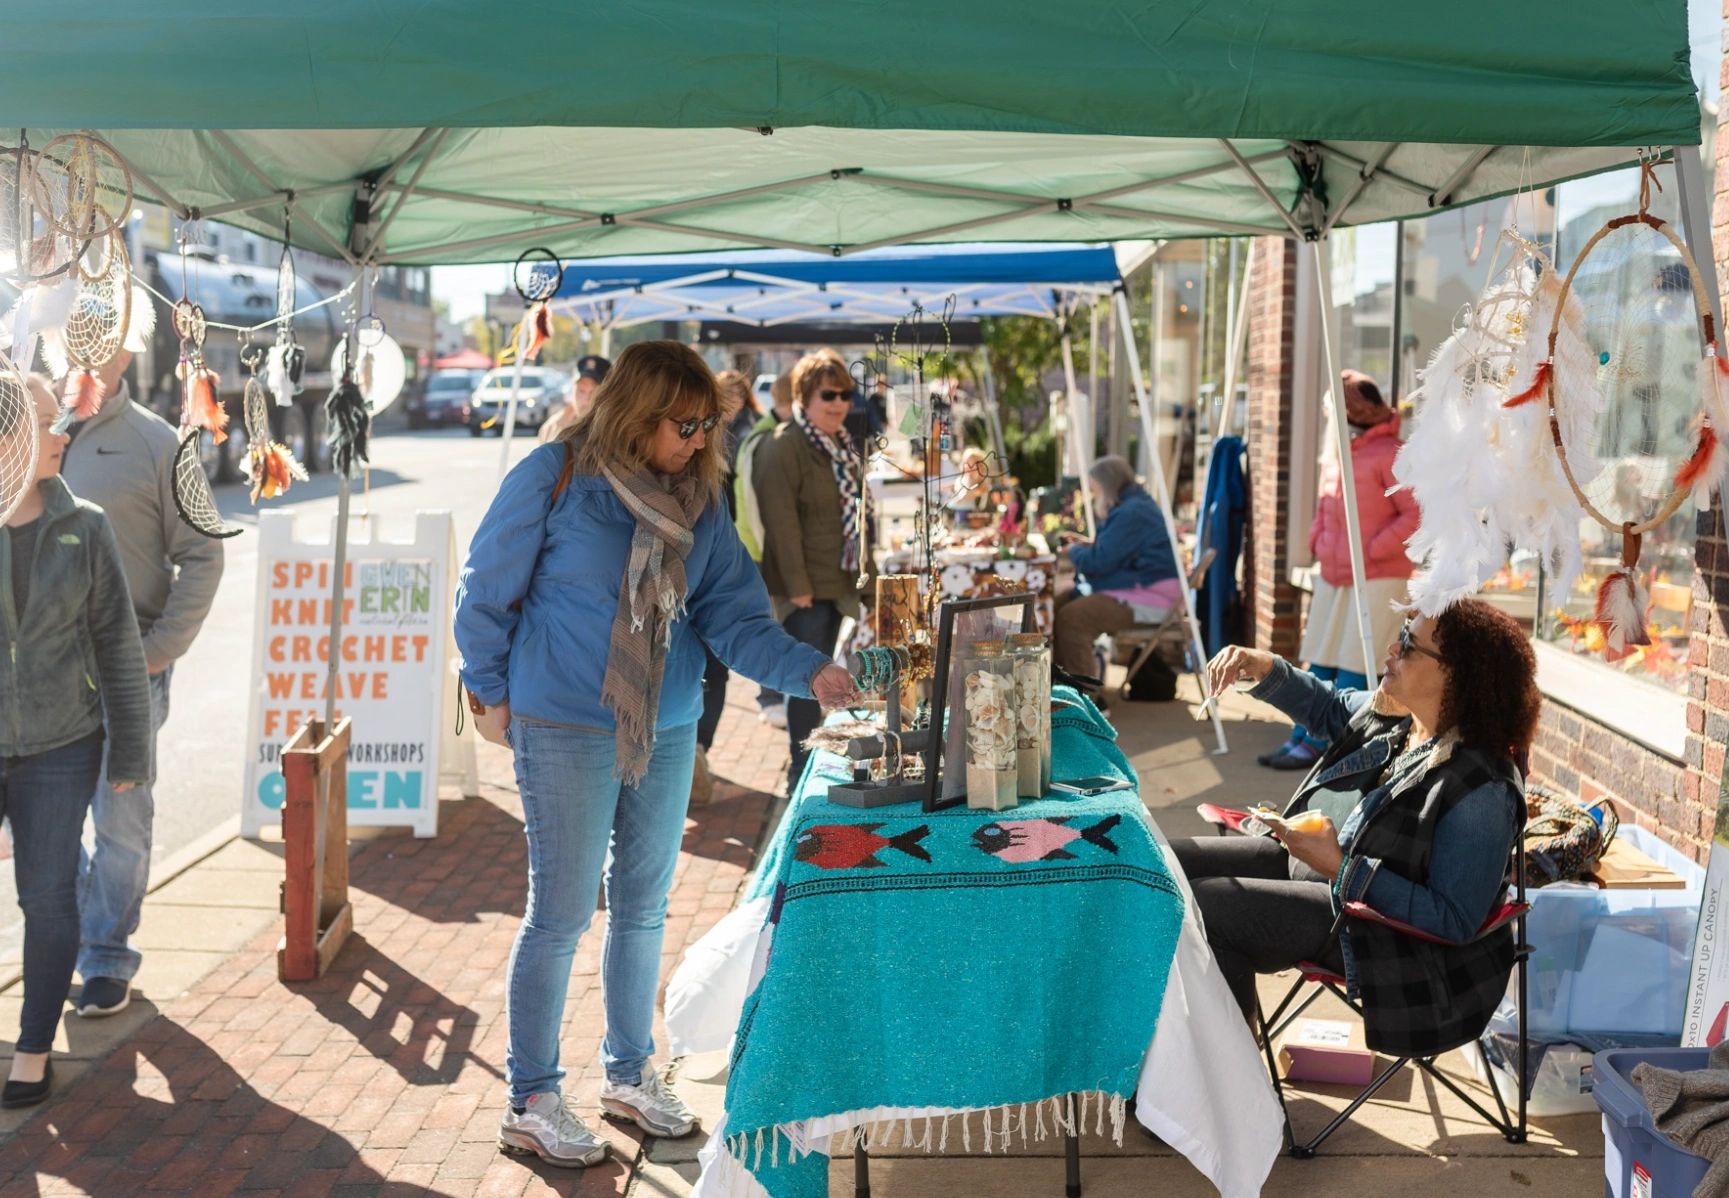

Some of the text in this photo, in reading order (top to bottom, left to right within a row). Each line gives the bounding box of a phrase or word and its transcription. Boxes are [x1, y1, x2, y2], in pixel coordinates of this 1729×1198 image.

[271, 598, 355, 626] KNIT
[360, 584, 429, 613] ERIN
[269, 634, 429, 663] CROCHET
[267, 671, 389, 700] WEAVE
[264, 709, 342, 737] FE
[258, 770, 422, 810] OEN
[1703, 888, 1718, 941] CANOPY
[1700, 944, 1711, 961] UP
[1691, 965, 1708, 1018] INSTANT
